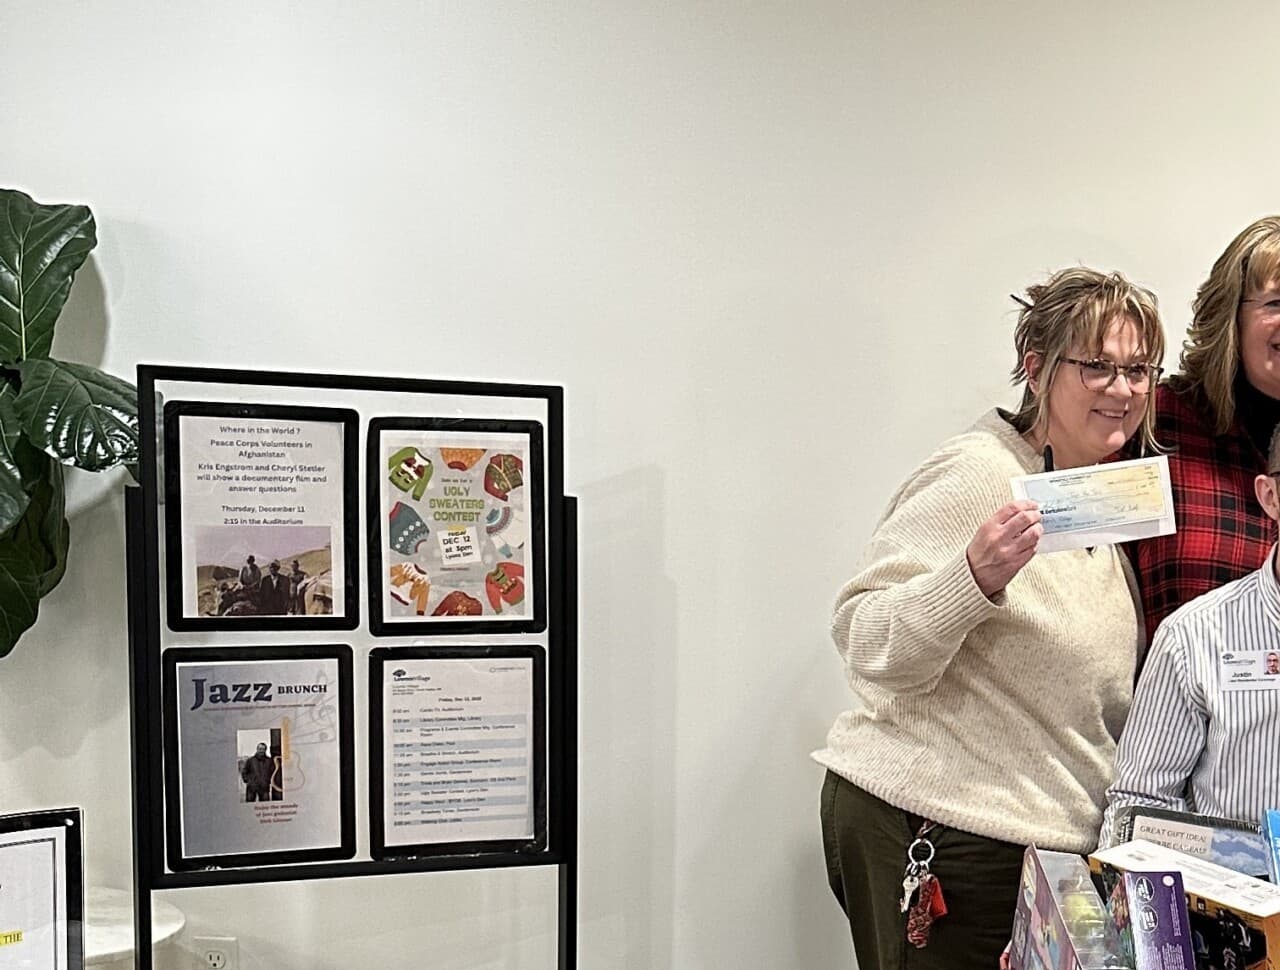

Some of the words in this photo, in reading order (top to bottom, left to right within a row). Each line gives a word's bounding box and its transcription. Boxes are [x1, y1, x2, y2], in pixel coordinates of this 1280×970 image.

[219, 426, 246, 434] Where
[271, 427, 294, 435] World
[210, 439, 234, 447] Peace
[235, 440, 260, 448] Corps
[238, 451, 286, 459] Afghanistan
[215, 464, 253, 472] Engstrom
[271, 464, 298, 473] Cheryl
[241, 475, 294, 483] documentary
[312, 475, 327, 483] and
[258, 485, 297, 494] questions
[443, 486, 470, 497] UGLY
[429, 498, 485, 509] SWEATERS
[221, 505, 257, 513] Thursday,
[258, 505, 296, 513] December
[433, 511, 481, 521] CONTEST
[442, 537, 459, 545] DEC
[456, 545, 473, 553] 3pm
[190, 678, 273, 711] Jazz
[277, 684, 328, 695] BRUNCH
[1140, 825, 1166, 835] GREAT
[4, 932, 23, 945] THE
